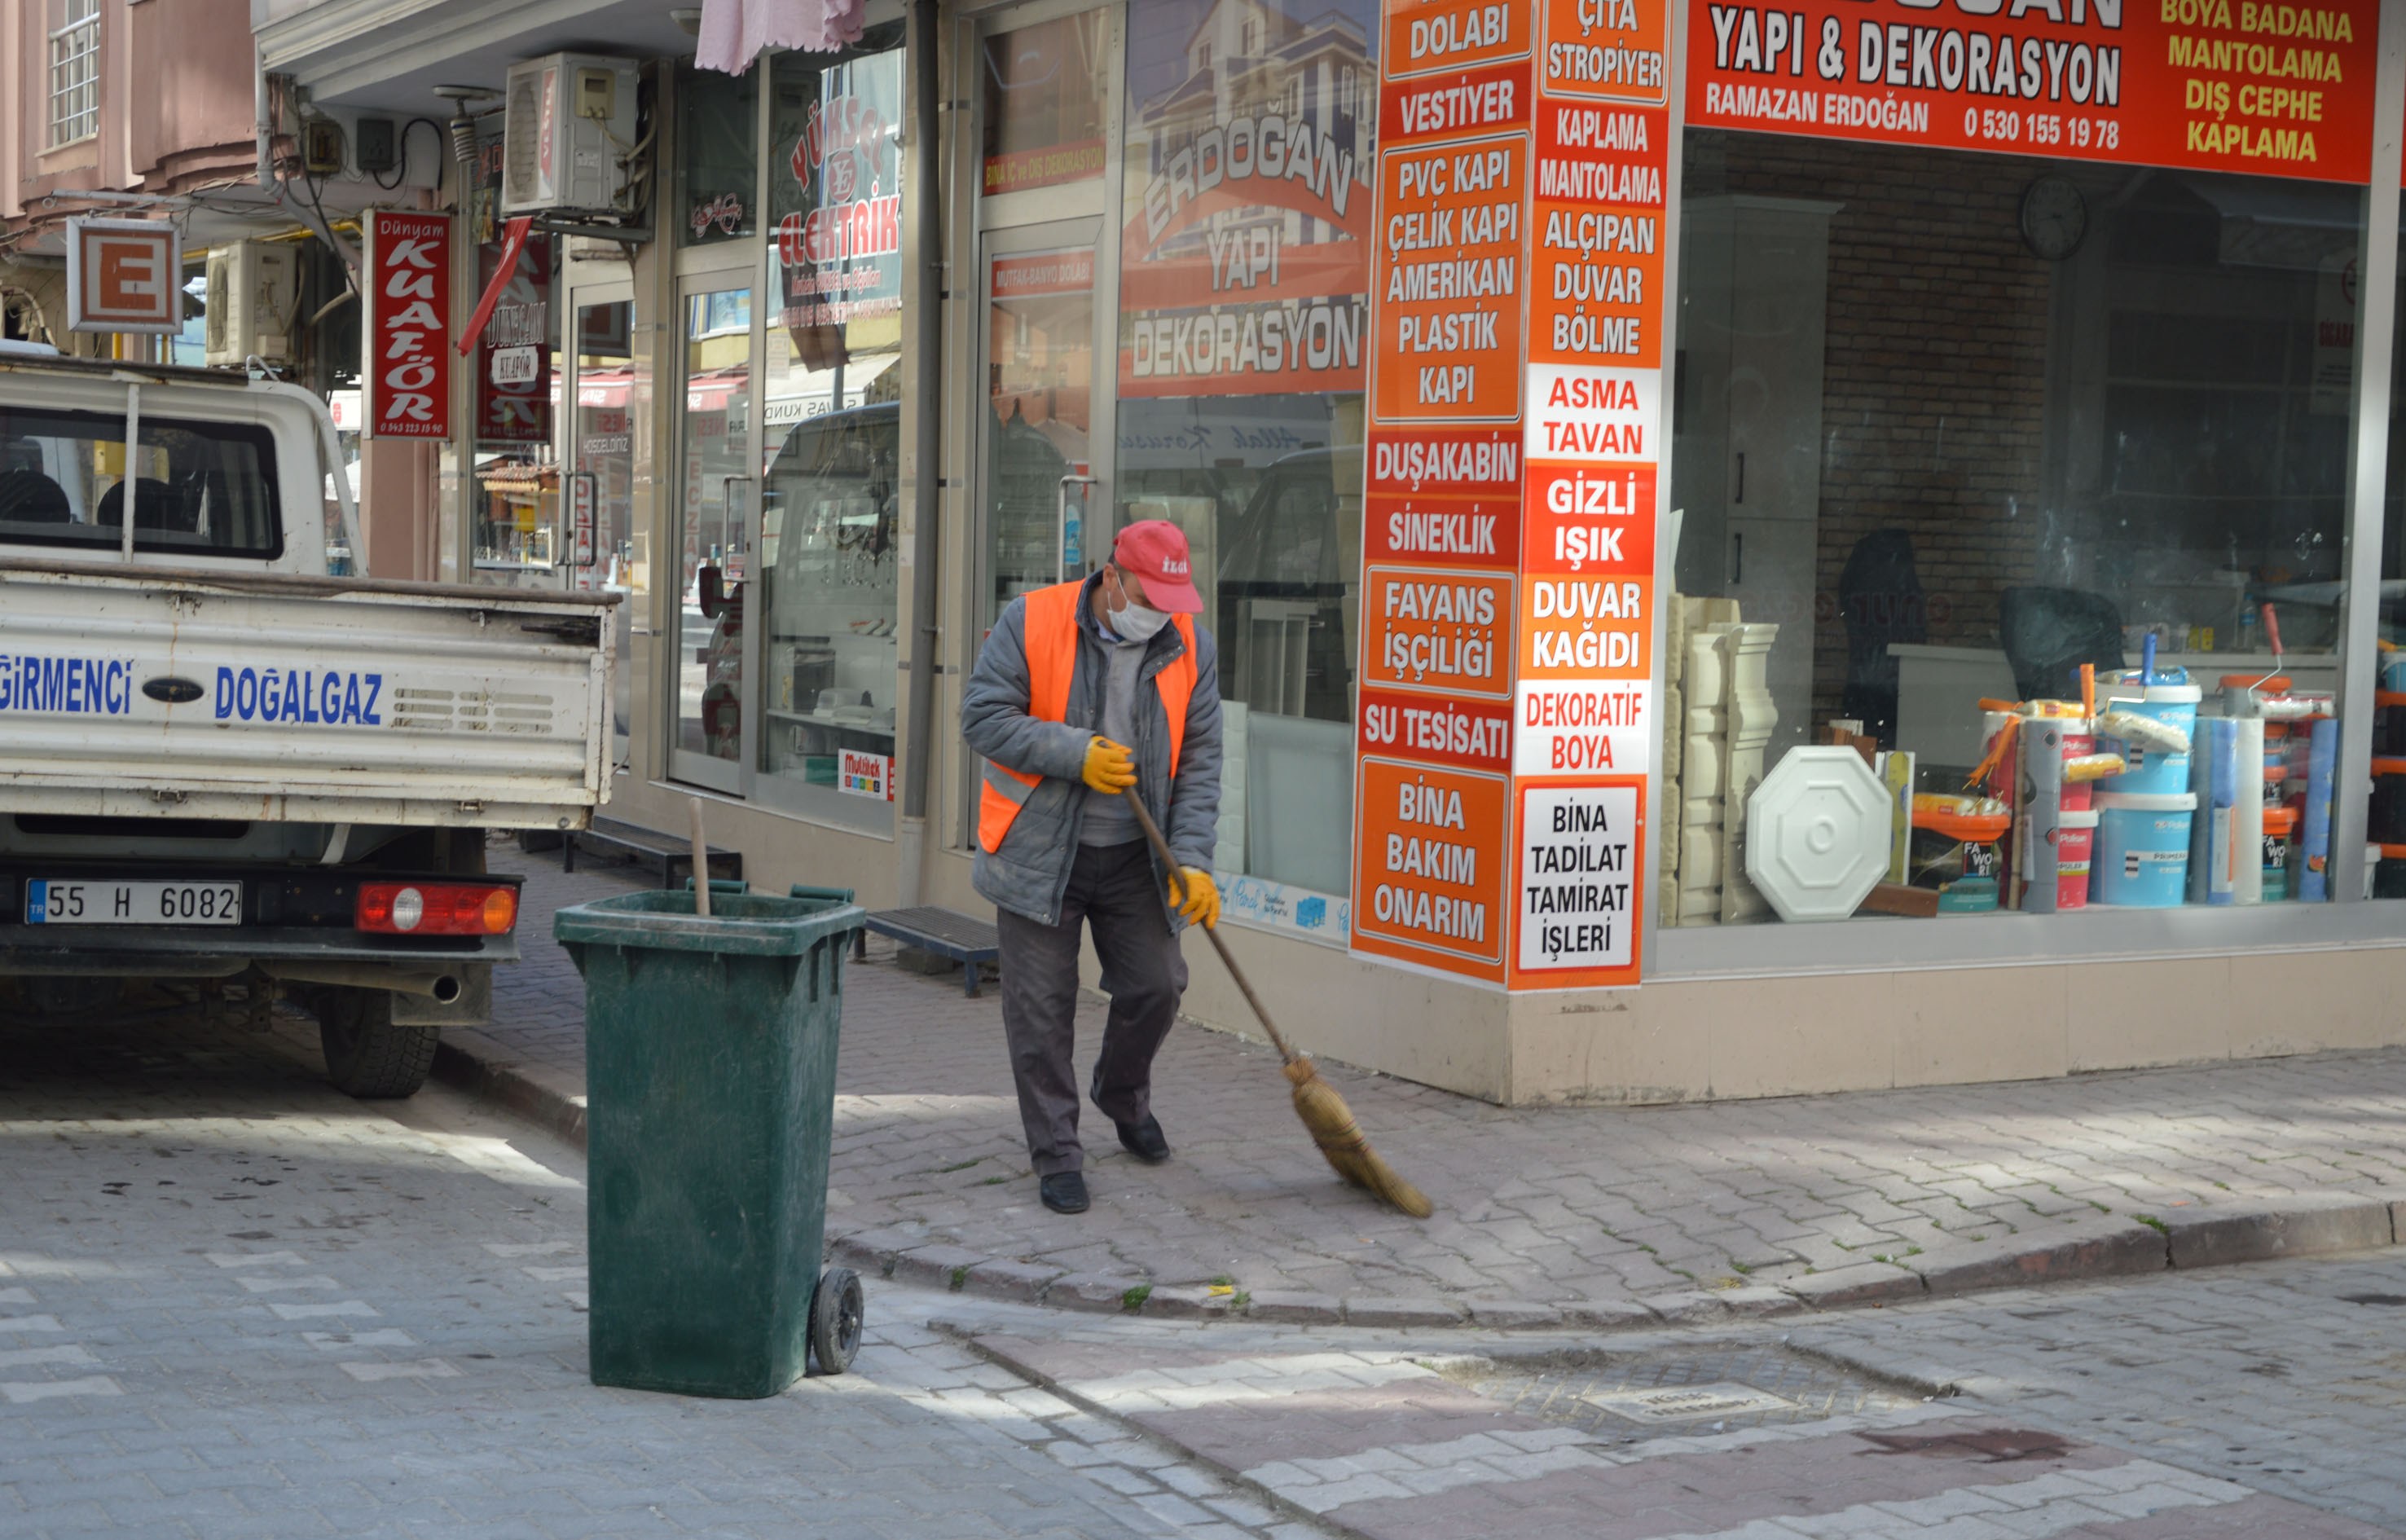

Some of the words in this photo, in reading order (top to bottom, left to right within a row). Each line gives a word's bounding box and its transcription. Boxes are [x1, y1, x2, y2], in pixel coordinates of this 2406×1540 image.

[1410, 2, 1509, 60] DOLABI
[2161, 0, 2232, 30] BOYA
[2241, 2, 2354, 43] BADANA
[1547, 38, 1664, 88] STROPİYER
[1709, 4, 1805, 77] YAPI
[1818, 15, 1845, 82] &
[1858, 20, 2121, 108] DEKORASYON
[2167, 35, 2342, 83] MANTOLAMA
[1400, 76, 1515, 134] VESTİYER
[1705, 82, 1818, 123] RAMAZAN
[1823, 91, 1929, 134] ERDOĞAN
[2185, 79, 2231, 121] DIŞ
[2238, 83, 2324, 122] CEPHE
[1556, 108, 1649, 152] KAPLAMA
[1964, 107, 1977, 138] 0
[1982, 108, 2020, 142] 530
[2026, 113, 2061, 145] 155
[2067, 117, 2089, 147] 19
[2096, 119, 2119, 149] 78
[2186, 121, 2318, 162] KAPLAMA
[1045, 146, 1105, 177] DEKORASYON
[1142, 99, 1354, 245] ERDOĞAN
[1399, 157, 1447, 200] PVC
[1453, 149, 1511, 194] KAPI
[1539, 157, 1662, 205] MANTOLAMA
[380, 219, 444, 240] Dünyam
[777, 179, 901, 267] ELEKTRİK
[1388, 200, 1454, 262] ÇELİK
[1460, 202, 1518, 245] KAPI
[1543, 210, 1656, 261] ALÇIPAN
[1206, 225, 1279, 293] YAPI
[1387, 251, 1515, 303] AMERİKAN
[1553, 262, 1643, 305] DUVAR
[385, 239, 443, 421] KUAFÖR
[1132, 301, 1362, 378] DEKORASYON
[1398, 302, 1499, 354] PLASTİK
[1552, 306, 1641, 355] BÖLME
[1419, 365, 1475, 404] KAPI
[1547, 377, 1639, 410] ASMA
[1375, 431, 1517, 492] DUŞAKABİN
[1542, 420, 1643, 455] TAVAN
[1546, 470, 1636, 516] GİZLİ
[1388, 502, 1496, 555] SİNEKLİK
[1554, 526, 1625, 571] IŞIK
[1385, 580, 1495, 627] FAYANS
[1532, 581, 1641, 619] DUVAR
[1383, 620, 1494, 682] İŞÇİLİĞİ
[1532, 621, 1640, 669] KAĞIDI
[214, 666, 383, 726] DOĞALGAZ
[1525, 682, 1643, 728] DEKORATİF
[1365, 703, 1397, 744] SU
[1403, 702, 1509, 760] TESİSATI
[1550, 735, 1614, 770] BOYA
[1398, 774, 1466, 832] BİNA
[1552, 797, 1608, 833] BİNA
[1387, 833, 1476, 888] BAKIM
[1531, 836, 1628, 874] TADİLAT
[30, 904, 45, 915] TR
[49, 887, 85, 917] 55
[114, 887, 130, 917] H
[161, 887, 235, 919] 6082
[1374, 882, 1486, 944] ONARIM
[1527, 876, 1629, 914] TAMİRAT
[1542, 916, 1612, 961] İŞLERİ
